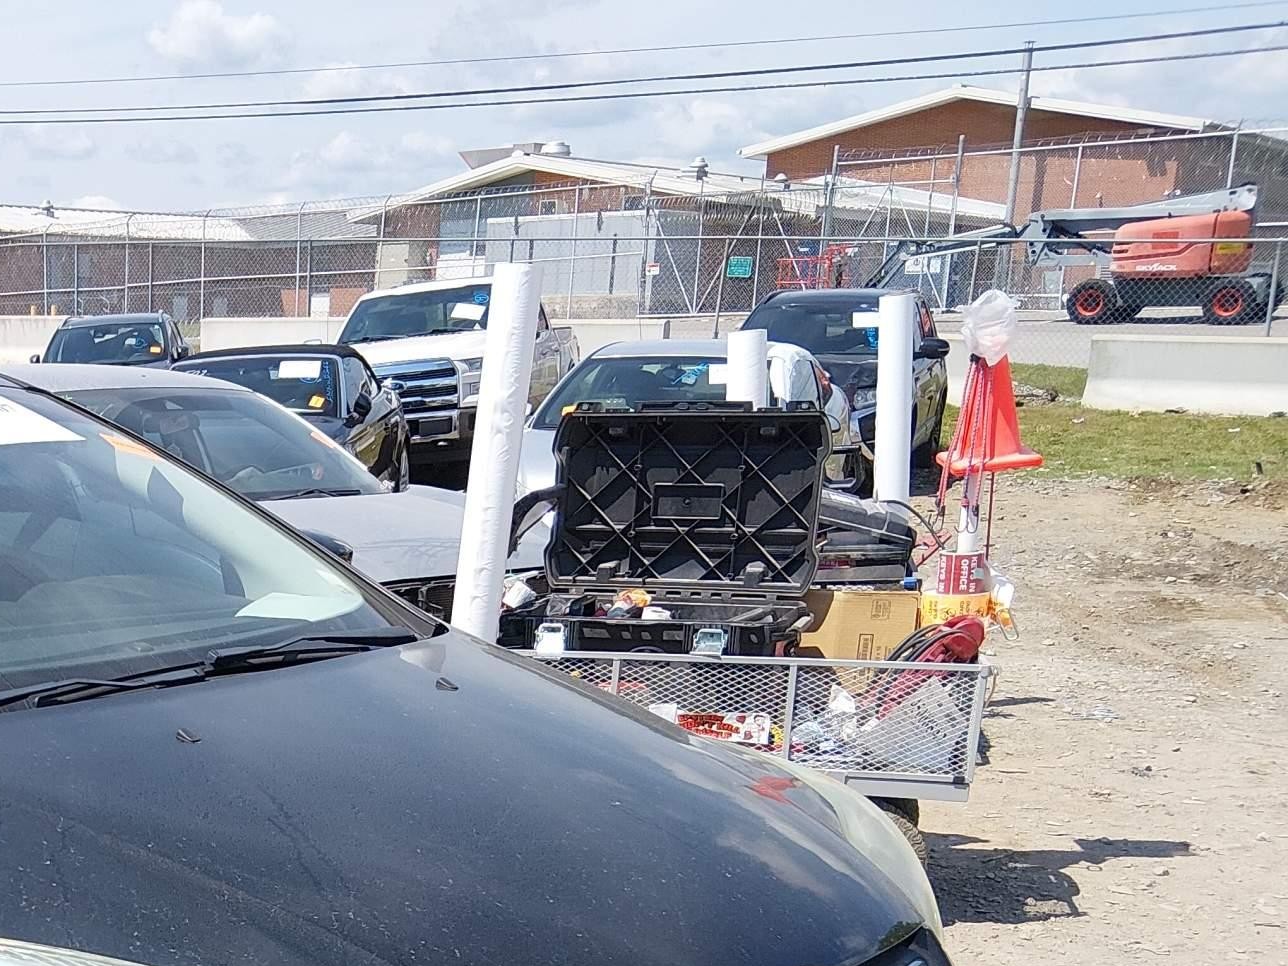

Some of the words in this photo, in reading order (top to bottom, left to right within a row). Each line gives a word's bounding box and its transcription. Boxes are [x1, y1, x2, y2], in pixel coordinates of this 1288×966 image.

[938, 556, 947, 581] KEYS
[958, 559, 970, 591] OFFICE
[968, 582, 976, 593] IN
